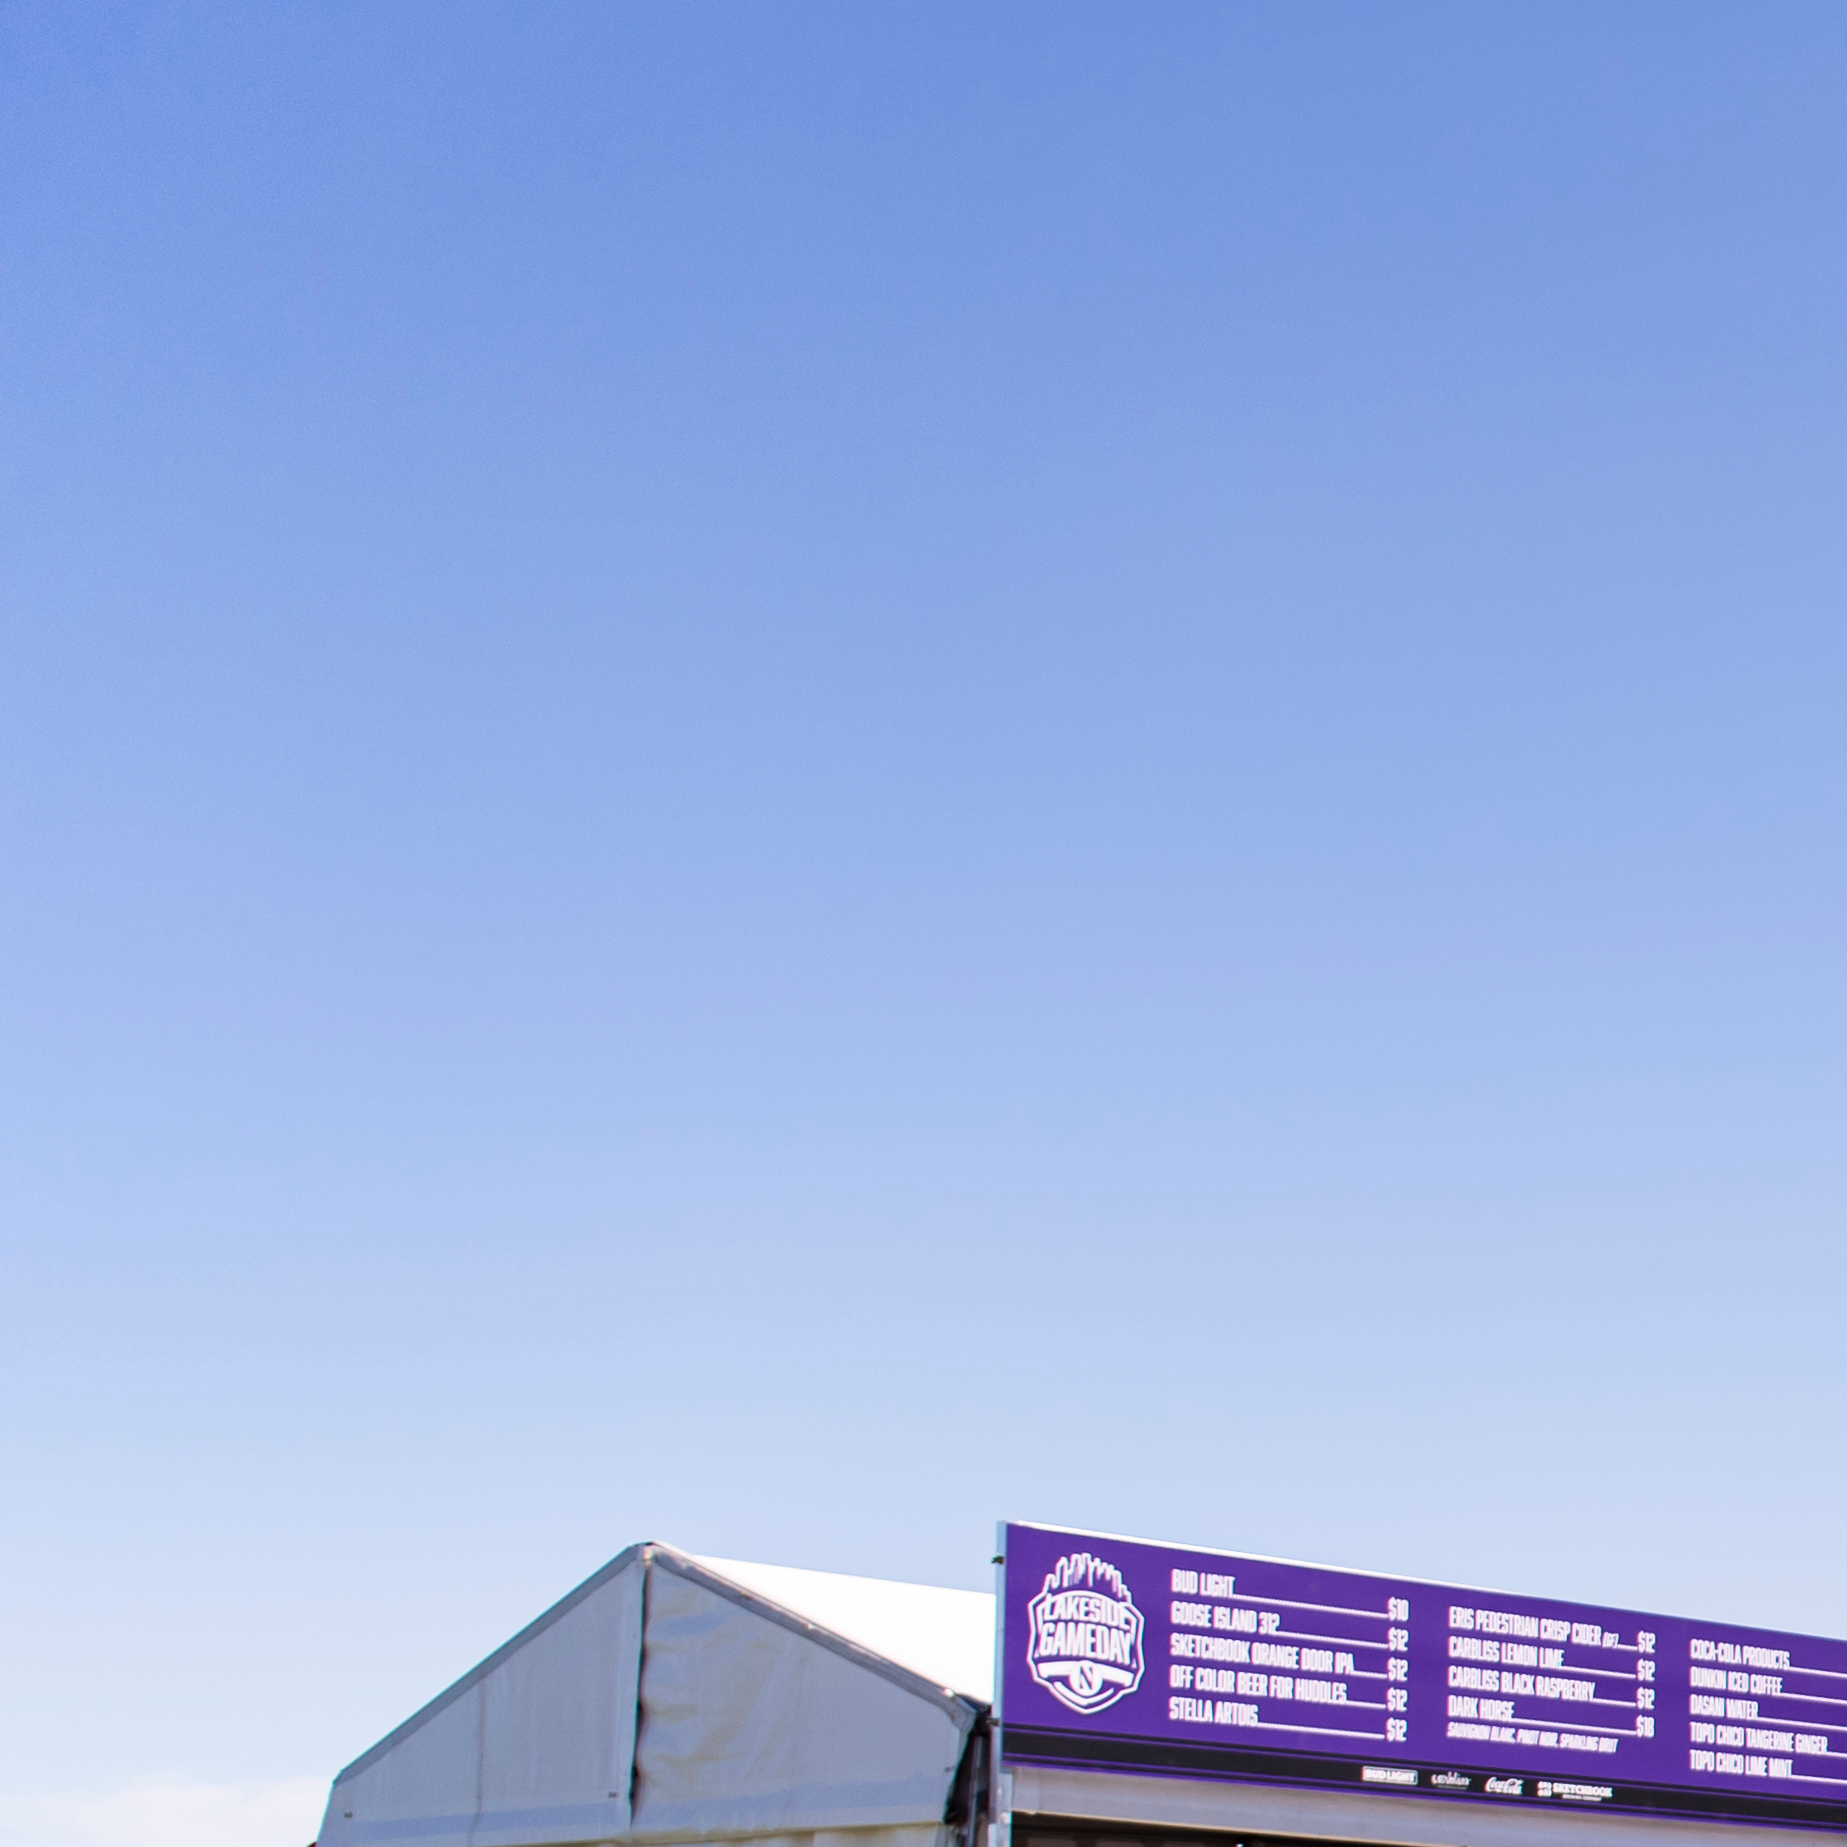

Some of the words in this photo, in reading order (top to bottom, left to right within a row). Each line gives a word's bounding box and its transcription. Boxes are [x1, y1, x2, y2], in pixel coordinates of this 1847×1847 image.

[1043, 1593, 1131, 1630] LAKESIDE
[1171, 1568, 1198, 1595] BUD
[1200, 1572, 1235, 1598] LIGHT
[1387, 1597, 1410, 1621] $10
[1039, 1621, 1132, 1665] GAMEDAY
[1171, 1601, 1212, 1627] GOOSE
[1213, 1606, 1257, 1633] ISLAND
[1258, 1612, 1280, 1634] 312
[1387, 1627, 1409, 1651] $12
[1449, 1606, 1474, 1629] ERIS
[1476, 1610, 1539, 1638] PEDESTRIAN
[1540, 1619, 1571, 1641] CRISP
[1572, 1623, 1601, 1645] CIDER
[1637, 1631, 1655, 1653] $12
[1170, 1632, 1251, 1663] SKETCHBOOK
[1251, 1641, 1299, 1669] ORANGE
[1301, 1648, 1333, 1673] DOOR
[1335, 1651, 1355, 1675] IPA
[1387, 1657, 1409, 1681] $12
[1449, 1636, 1499, 1662] CARBLISS
[1502, 1642, 1538, 1666] LEMON
[1539, 1647, 1564, 1668] LIME
[1637, 1659, 1655, 1681] $12
[1690, 1639, 1742, 1665] COCA-COLA
[1743, 1645, 1790, 1669] PRODUCTS
[1170, 1664, 1194, 1688] OFF
[1195, 1667, 1235, 1693] COLOR
[1237, 1671, 1268, 1696] BEER
[1269, 1675, 1294, 1699] FOR
[1295, 1678, 1347, 1704] HUDDLES
[1387, 1687, 1408, 1711] $12
[1448, 1665, 1499, 1691] CARBLISS
[1501, 1671, 1535, 1695] BLACK
[1535, 1676, 1595, 1702] RASPBERRY
[1636, 1687, 1655, 1709] $12
[1690, 1666, 1726, 1689] DUNKIN
[1728, 1671, 1748, 1692] ICED
[1750, 1674, 1782, 1696] COFFEE
[1169, 1696, 1213, 1722] STELLA
[1214, 1701, 1258, 1726] ARTOIS
[1387, 1718, 1407, 1742] $12
[1448, 1695, 1478, 1718] DARK
[1479, 1698, 1515, 1720] HORSE
[1636, 1715, 1655, 1737] $18
[1690, 1694, 1725, 1717] DASANI
[1726, 1698, 1758, 1720] WATER
[1690, 1721, 1715, 1744] TOPO
[1716, 1724, 1744, 1747] CHICO
[1746, 1728, 1794, 1752] TANGERINE
[1795, 1734, 1827, 1754] GINGER
[1364, 1769, 1387, 1780] BUD
[1387, 1770, 1416, 1782] LIGHT
[1690, 1749, 1715, 1771] TOPO
[1716, 1752, 1744, 1775] CHICO
[1745, 1755, 1767, 1776] LIME
[1769, 1758, 1793, 1778] MINT
[1553, 1782, 1613, 1797] SKETCHBOOK
